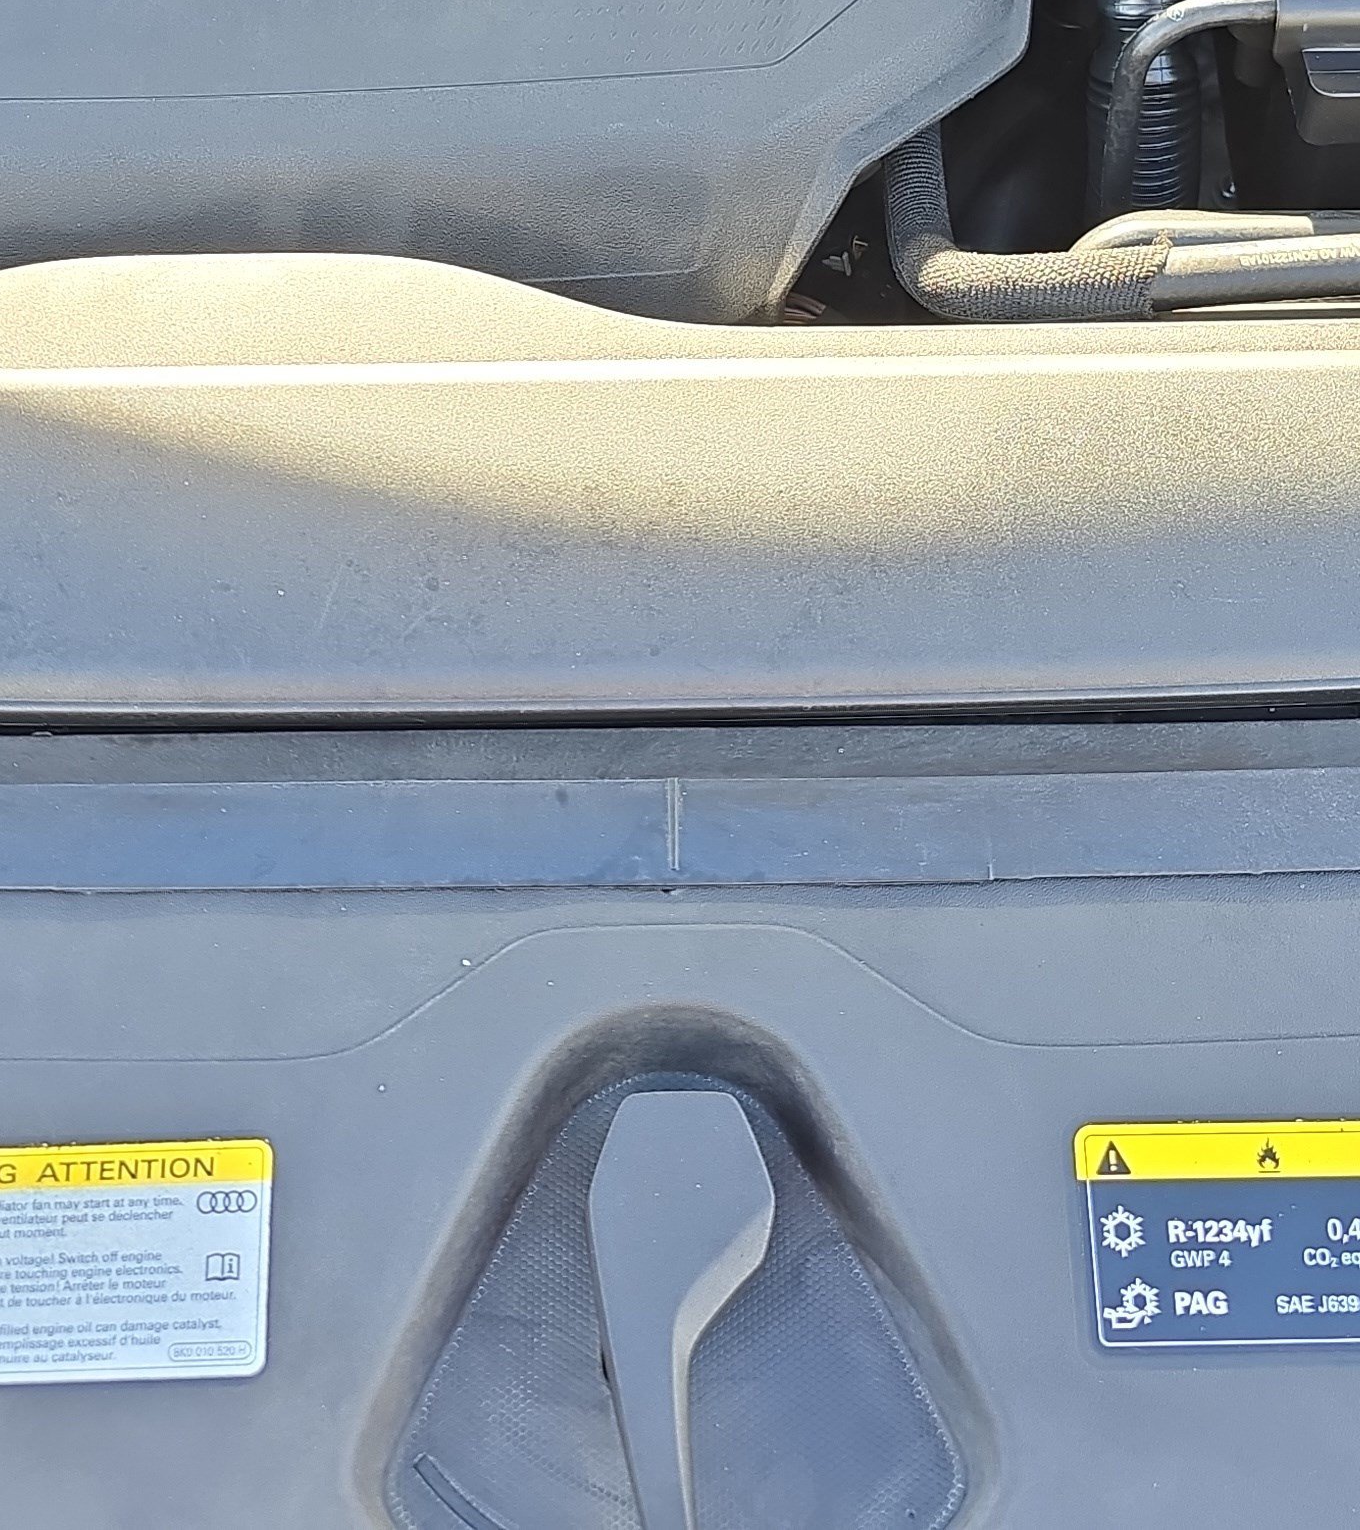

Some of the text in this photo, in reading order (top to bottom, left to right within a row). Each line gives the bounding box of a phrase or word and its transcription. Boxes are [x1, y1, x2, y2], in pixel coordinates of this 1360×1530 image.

[36, 1157, 216, 1183] ATTENTION
[32, 1199, 51, 1211] fan
[54, 1200, 80, 1213] may
[83, 1198, 110, 1209] start
[113, 1198, 125, 1208] at
[128, 1198, 148, 1209] any
[61, 1211, 88, 1224] peut
[91, 1212, 106, 1222] se
[1167, 1218, 1273, 1247] R-1234yf
[6, 1253, 54, 1268] voltage!
[58, 1252, 99, 1265] Switch
[102, 1251, 119, 1263] off
[122, 1251, 162, 1265] engine
[1170, 1250, 1216, 1267] GWP
[1218, 1250, 1232, 1267] 4
[14, 1267, 68, 1282] touching
[71, 1266, 112, 1280] engine
[10, 1280, 60, 1294] tension!
[108, 1278, 119, 1290] le
[122, 1278, 166, 1290] moteur
[8, 1295, 23, 1307] de
[26, 1294, 71, 1307] toucher
[171, 1290, 186, 1302] du
[190, 1289, 237, 1301] moteur.
[1173, 1291, 1229, 1315] PAG
[1276, 1295, 1315, 1314] SAE
[1318, 1294, 1360, 1313] J639
[32, 1323, 74, 1337] engine
[77, 1321, 92, 1333] oil
[95, 1322, 117, 1333] can
[120, 1320, 170, 1334] damage
[68, 1335, 117, 1348] excessif
[120, 1333, 161, 1346] d'huile
[0, 1351, 30, 1364] nuire
[33, 1351, 49, 1363] au
[217, 1344, 234, 1356] 520
